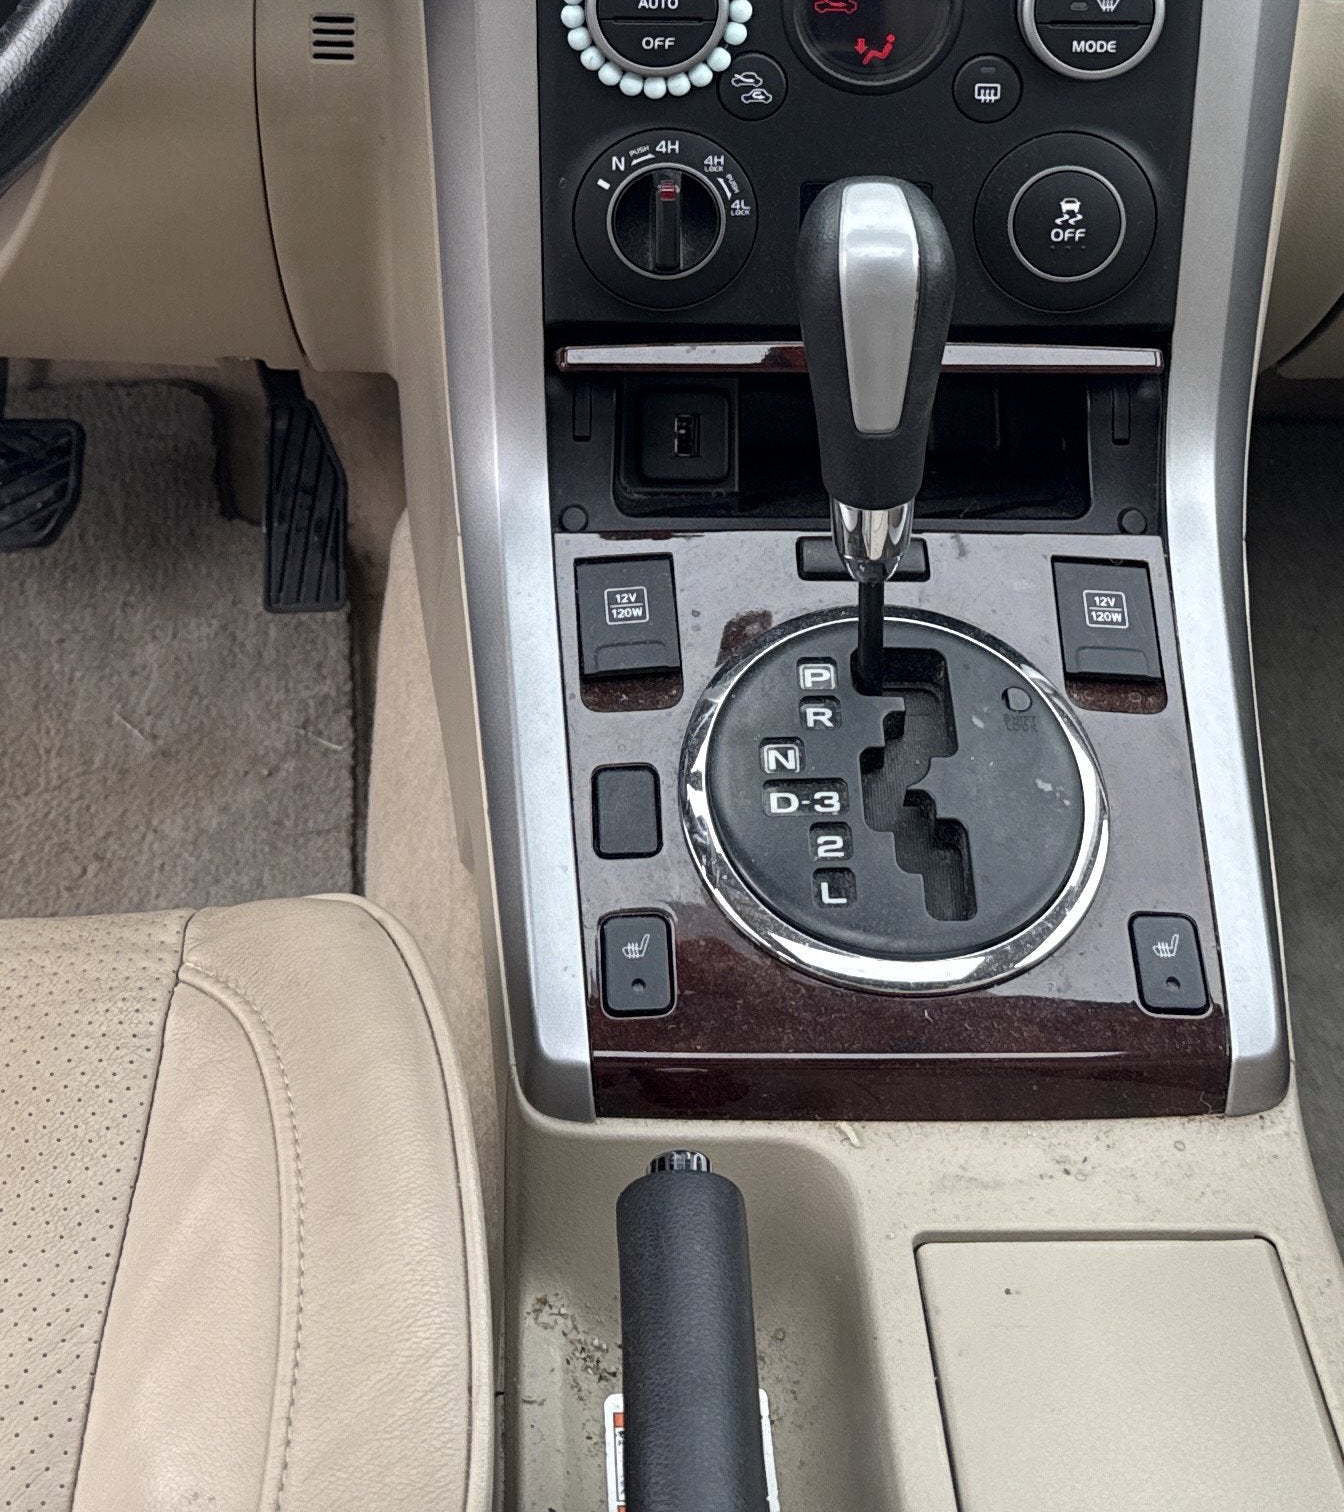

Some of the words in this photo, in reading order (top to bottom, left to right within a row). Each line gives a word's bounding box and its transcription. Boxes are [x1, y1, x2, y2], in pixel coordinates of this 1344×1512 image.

[641, 36, 676, 50] OFF
[1072, 40, 1117, 53] MODE
[628, 144, 651, 157] PUSH
[655, 139, 680, 154] 4H
[611, 155, 626, 172] N
[703, 154, 725, 167] 4H
[704, 165, 724, 173] LOCK
[730, 199, 752, 211] 4L
[730, 209, 751, 217] LOCK
[1050, 228, 1087, 242] OFF
[615, 592, 637, 604] 12V
[1093, 595, 1116, 607] 12V
[611, 607, 643, 619] 120W
[1090, 611, 1122, 623] 120W
[804, 668, 831, 688] P
[805, 707, 834, 727] R
[768, 749, 797, 770] N
[816, 835, 845, 858] 2
[820, 882, 848, 904] L
